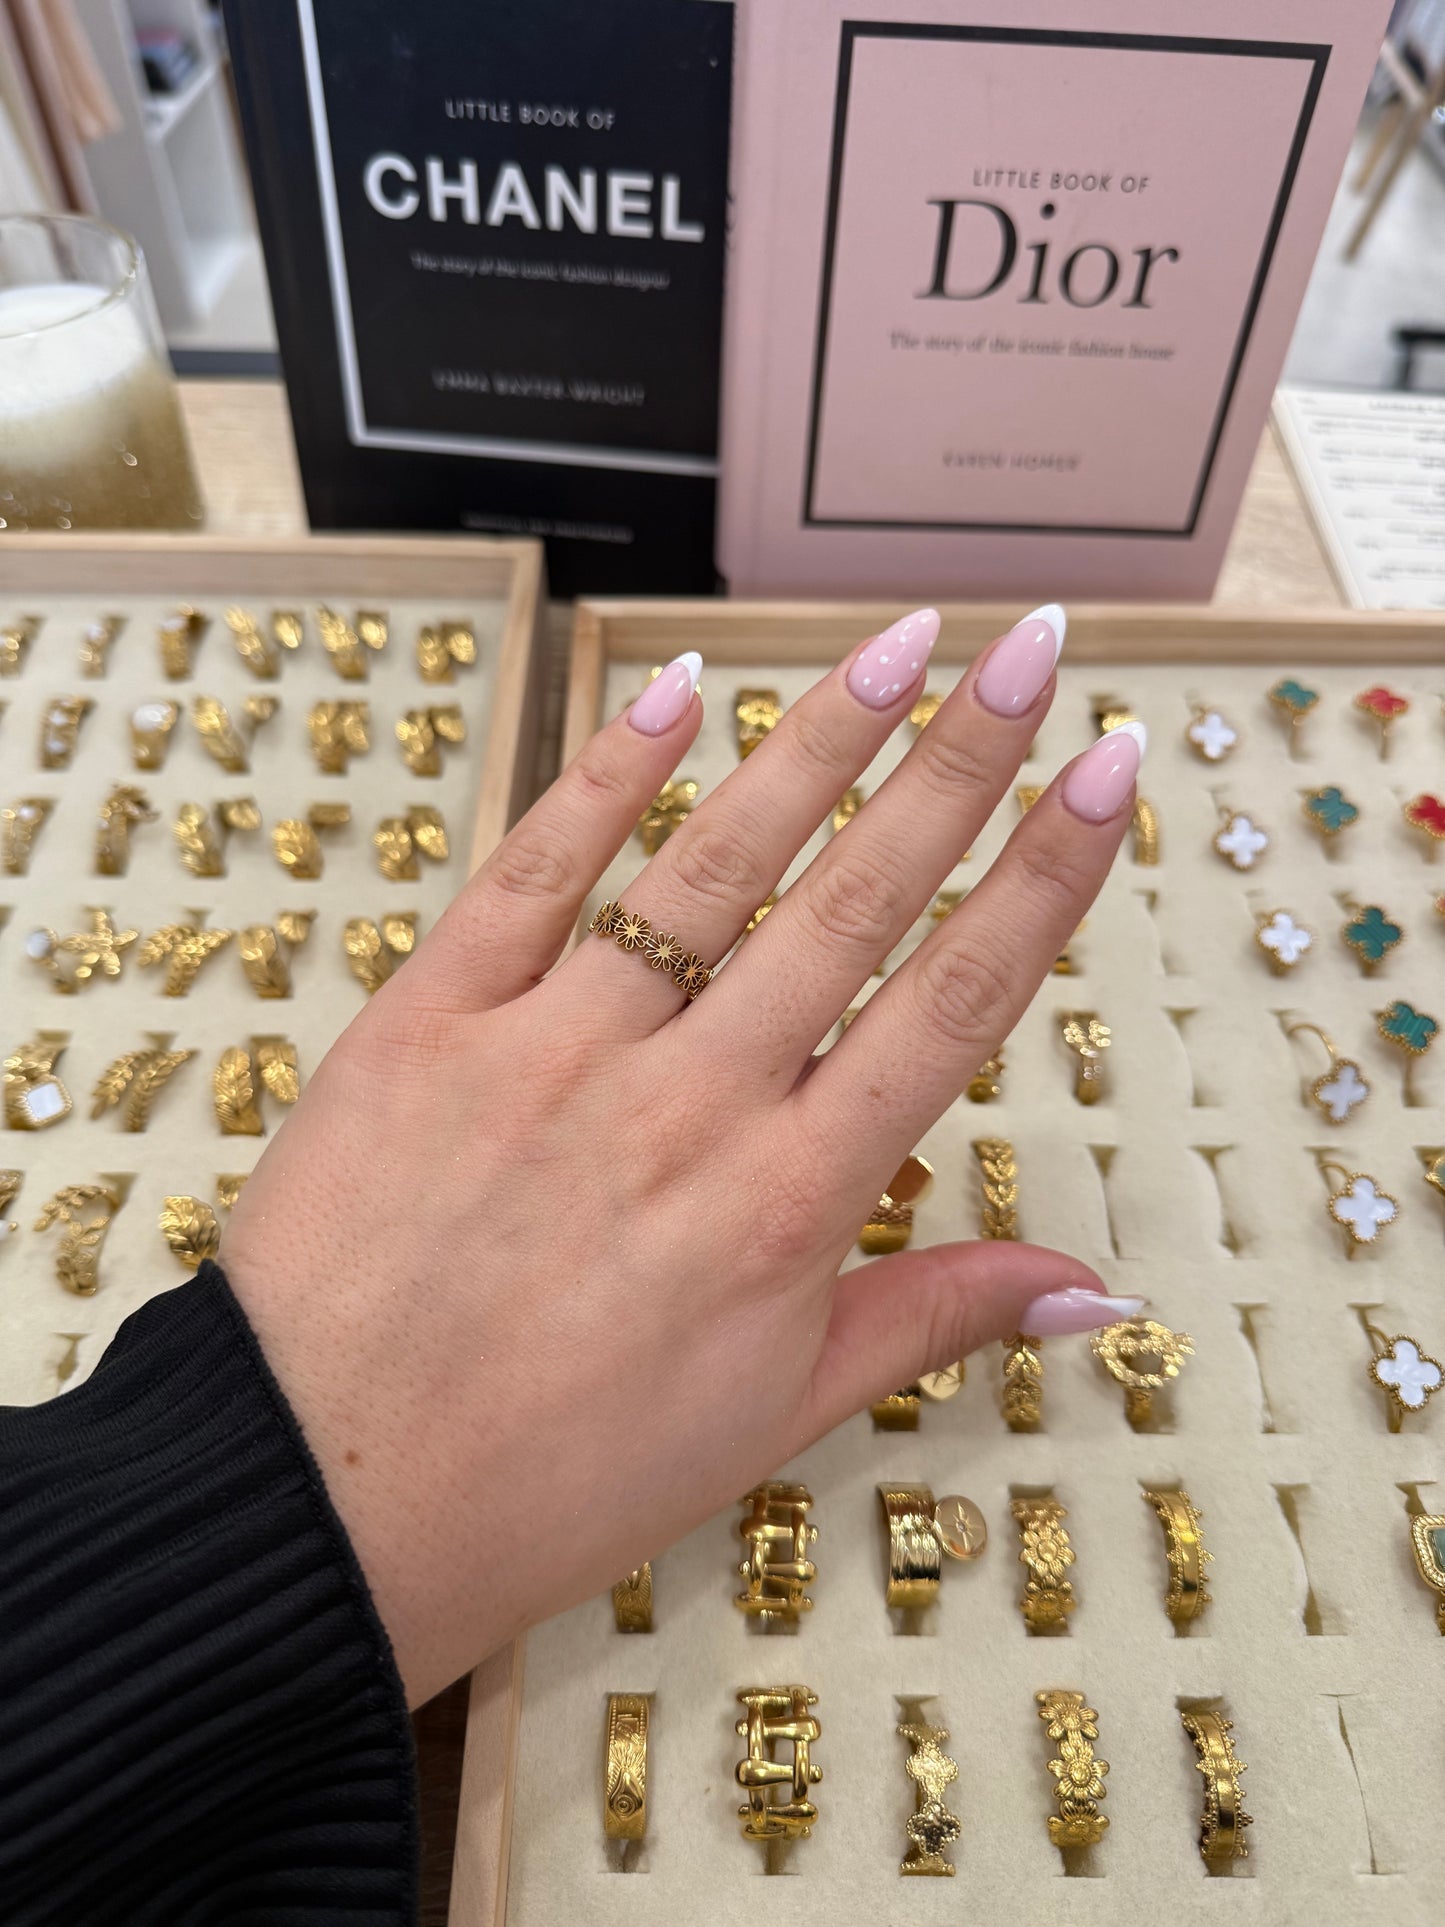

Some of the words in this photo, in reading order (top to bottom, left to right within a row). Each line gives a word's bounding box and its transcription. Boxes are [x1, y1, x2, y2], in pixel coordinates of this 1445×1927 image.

[445, 98, 511, 123] LITTLE
[519, 102, 579, 128] BOOK
[586, 108, 615, 131] OF
[363, 152, 705, 243] CHANEL
[972, 168, 1040, 189] LITTLE
[1050, 172, 1111, 191] BOOK
[1120, 175, 1149, 194] OF
[913, 197, 1181, 309] Dior
